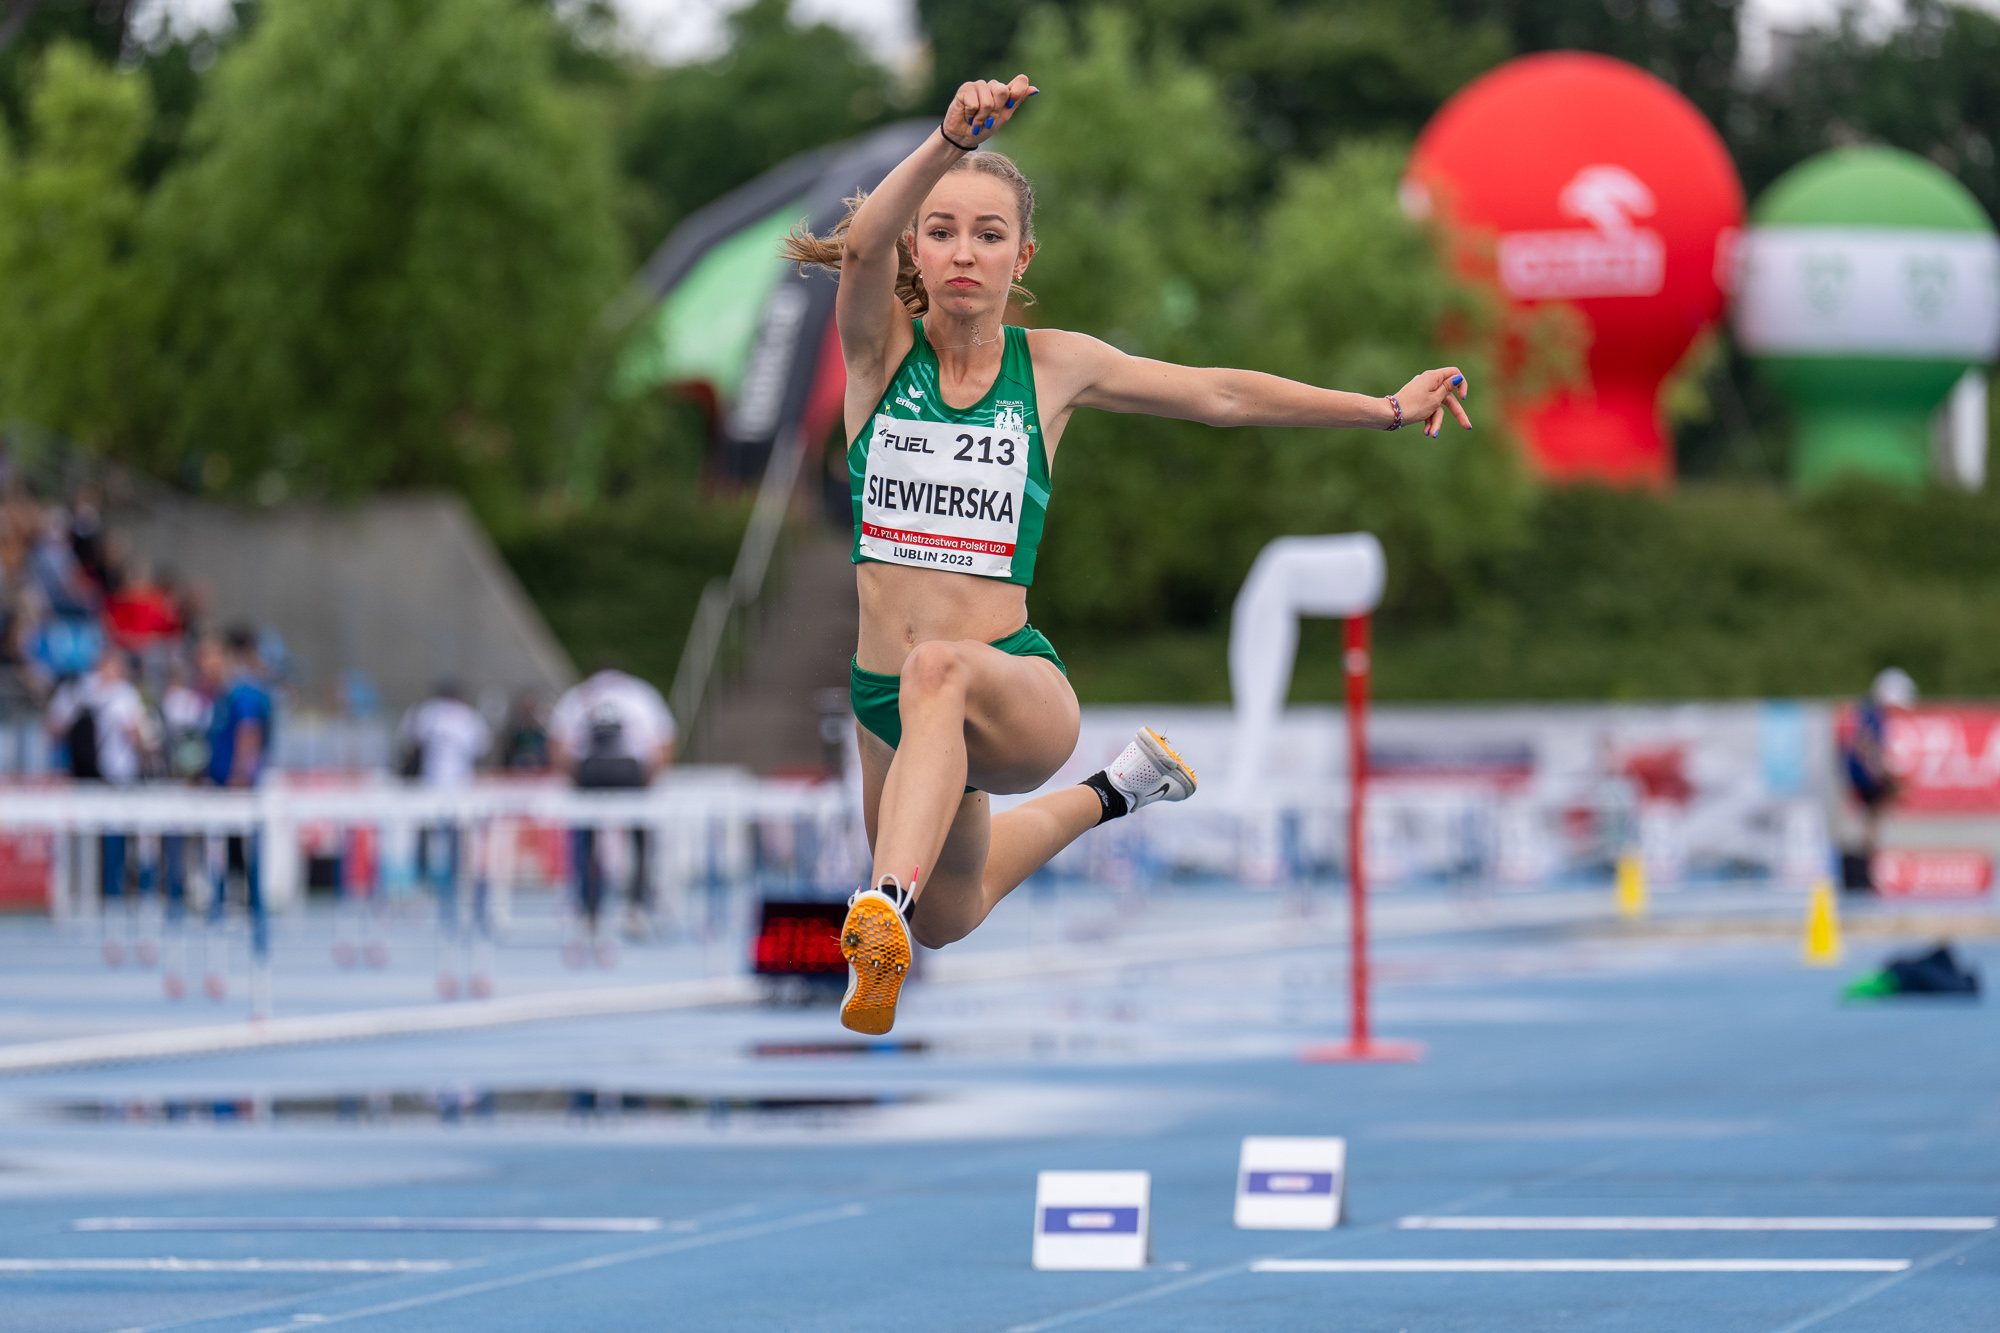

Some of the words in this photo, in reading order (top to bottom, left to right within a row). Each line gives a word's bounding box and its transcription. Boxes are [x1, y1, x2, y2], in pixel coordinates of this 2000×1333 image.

[895, 396, 921, 413] erima
[953, 433, 1014, 466] 213
[867, 474, 1014, 524] SIEWIERSKA
[869, 526, 880, 537] 77.
[881, 529, 900, 541] PZLA
[901, 533, 958, 548] Mistrzostwa
[960, 540, 988, 552] Polski
[989, 544, 1007, 554] U20
[893, 546, 938, 562] LUBLIN
[940, 553, 973, 566] 2023
